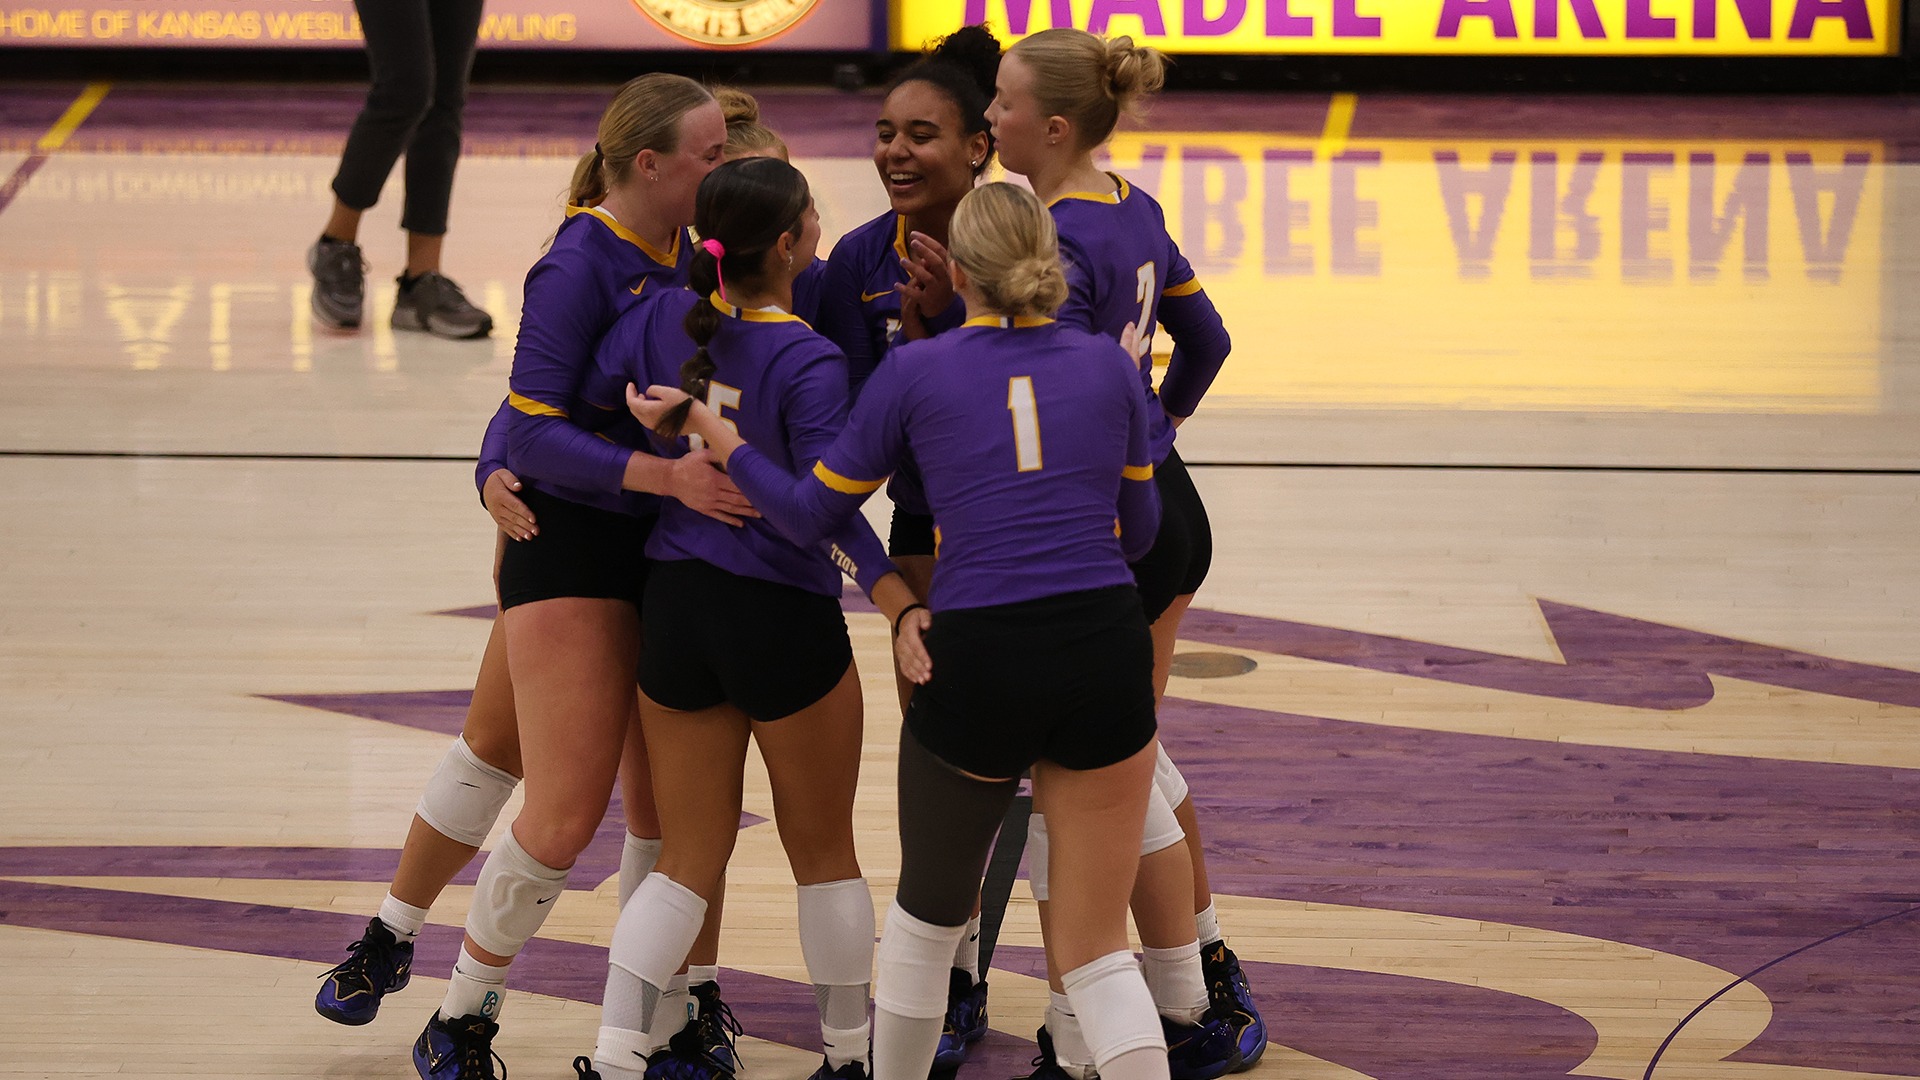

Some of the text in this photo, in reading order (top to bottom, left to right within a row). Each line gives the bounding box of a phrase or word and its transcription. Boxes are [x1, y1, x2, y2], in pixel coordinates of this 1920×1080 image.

[0, 10, 87, 38] HOME
[91, 10, 132, 39] OF
[138, 11, 263, 39] KANSAS
[264, 12, 366, 40] WESLE
[1007, 376, 1043, 473] 1
